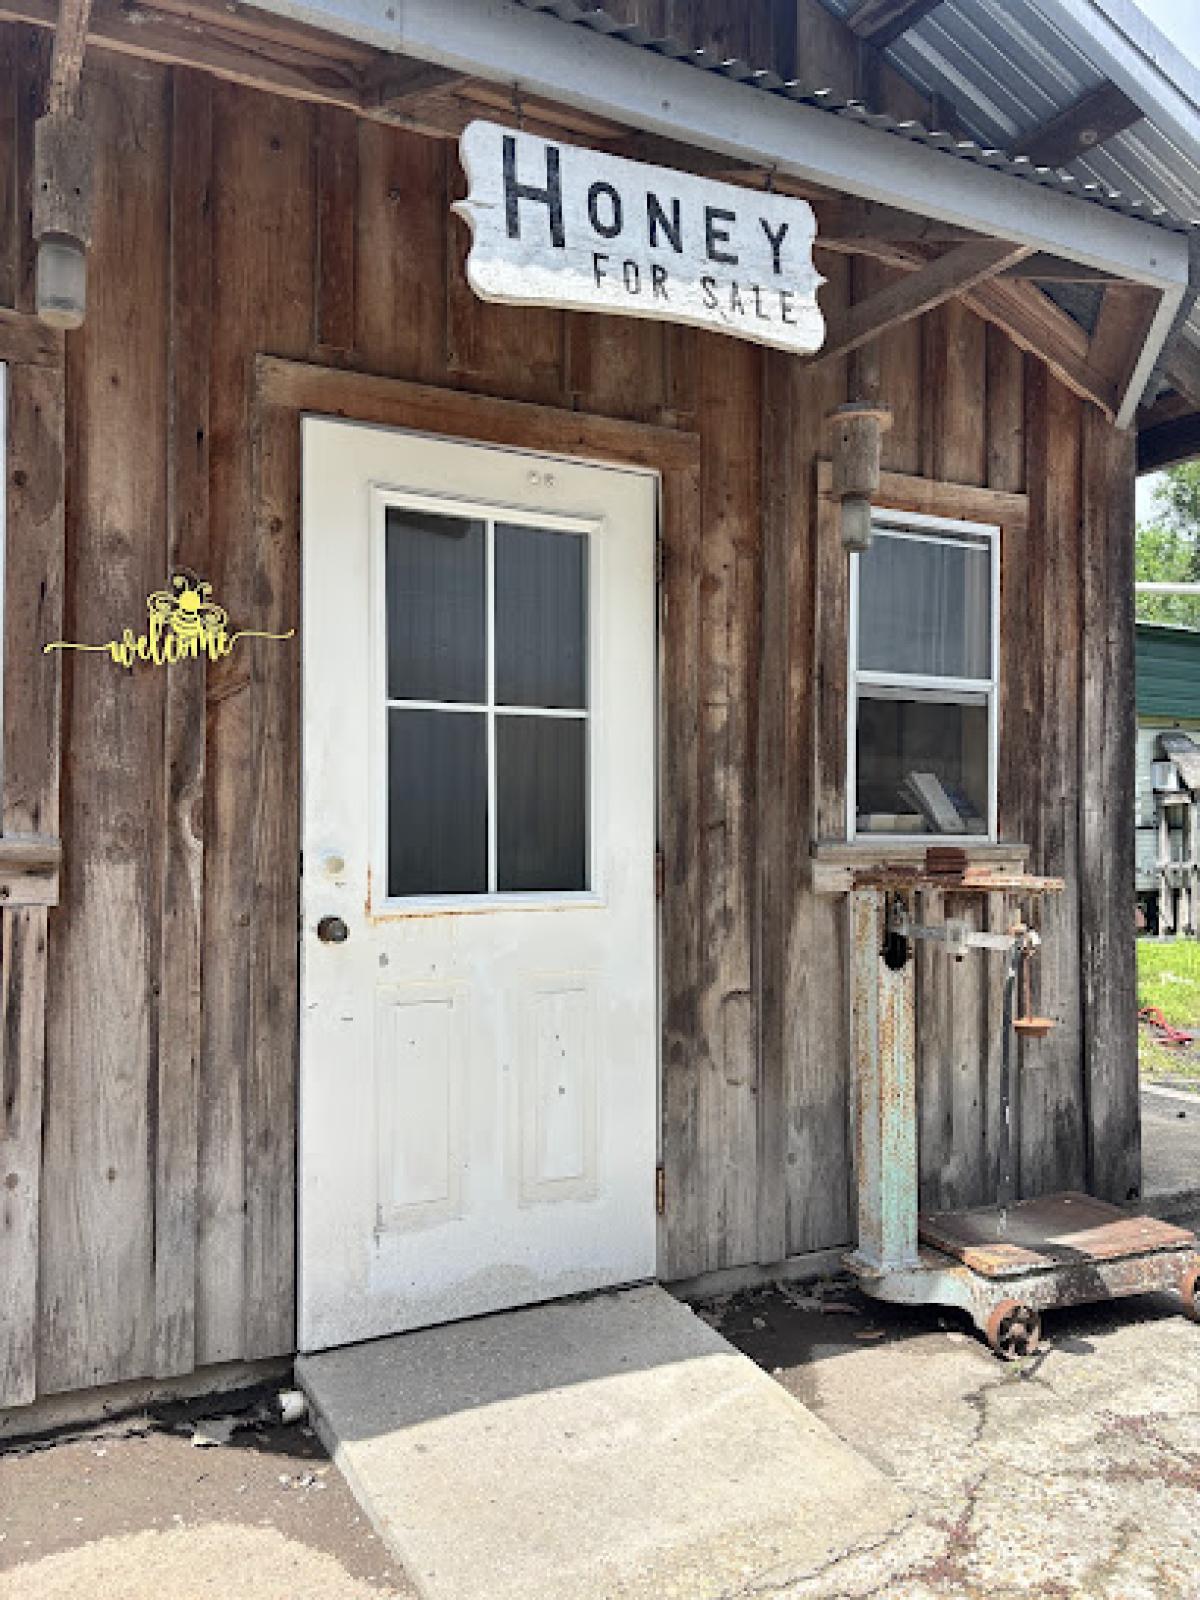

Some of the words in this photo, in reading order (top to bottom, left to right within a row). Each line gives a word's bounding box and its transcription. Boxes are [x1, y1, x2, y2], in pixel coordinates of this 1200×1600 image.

[502, 134, 789, 274] HONEY
[592, 252, 670, 300] FOR
[700, 275, 798, 325] SALE
[106, 606, 235, 668] welcome
